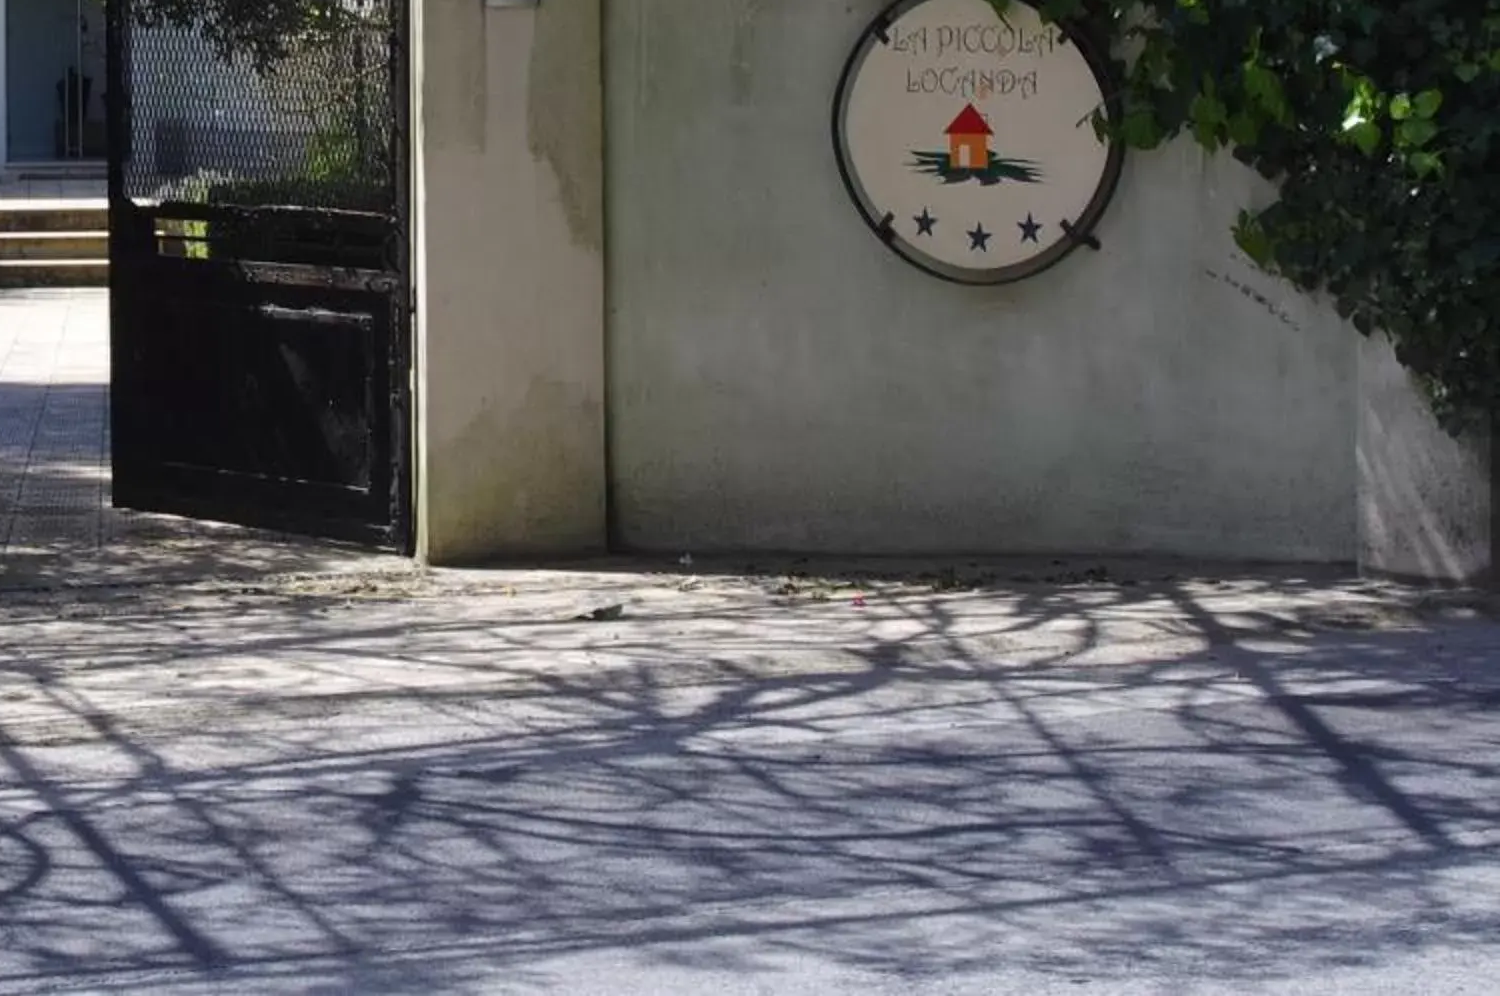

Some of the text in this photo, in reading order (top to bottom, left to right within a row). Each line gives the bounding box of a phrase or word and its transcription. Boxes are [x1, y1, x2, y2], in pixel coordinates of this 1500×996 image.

[893, 23, 1054, 57] LA PICCOLA
[906, 65, 1038, 99] LOCANDA
